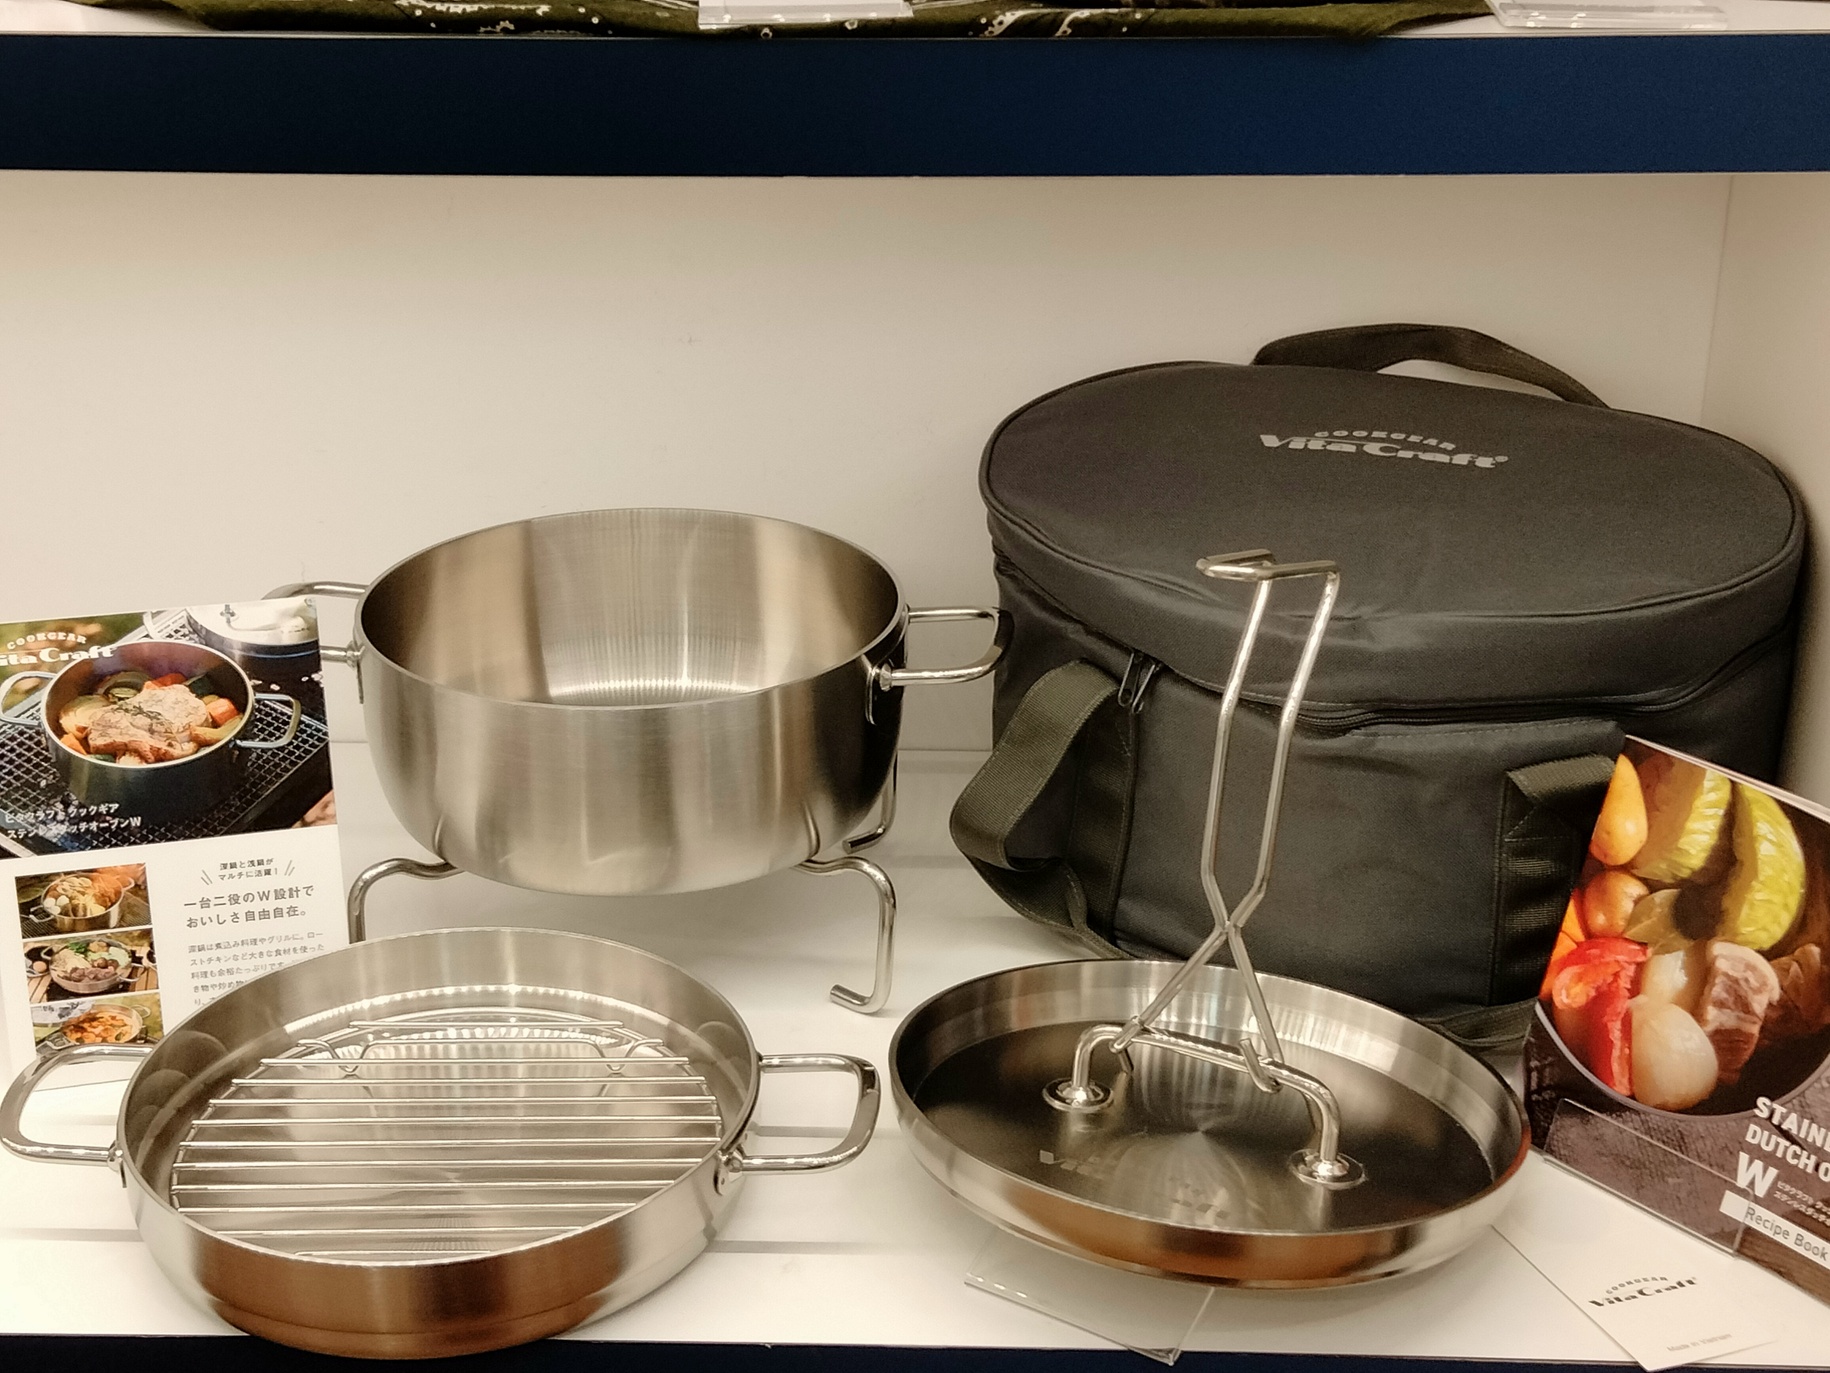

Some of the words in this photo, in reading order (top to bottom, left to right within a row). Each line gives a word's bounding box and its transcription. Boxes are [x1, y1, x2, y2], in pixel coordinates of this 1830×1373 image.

[7, 631, 87, 650] COOKGEAR
[183, 885, 315, 909] 一台二役のW設計で
[186, 905, 307, 929] おいしさ自由自在。
[191, 961, 288, 980] 料理も余裕たっぷりです
[1745, 1123, 1818, 1175] DUTCH
[1736, 1151, 1779, 1199] W
[1745, 1205, 1790, 1240] Recipe
[1794, 1233, 1828, 1261] Book
